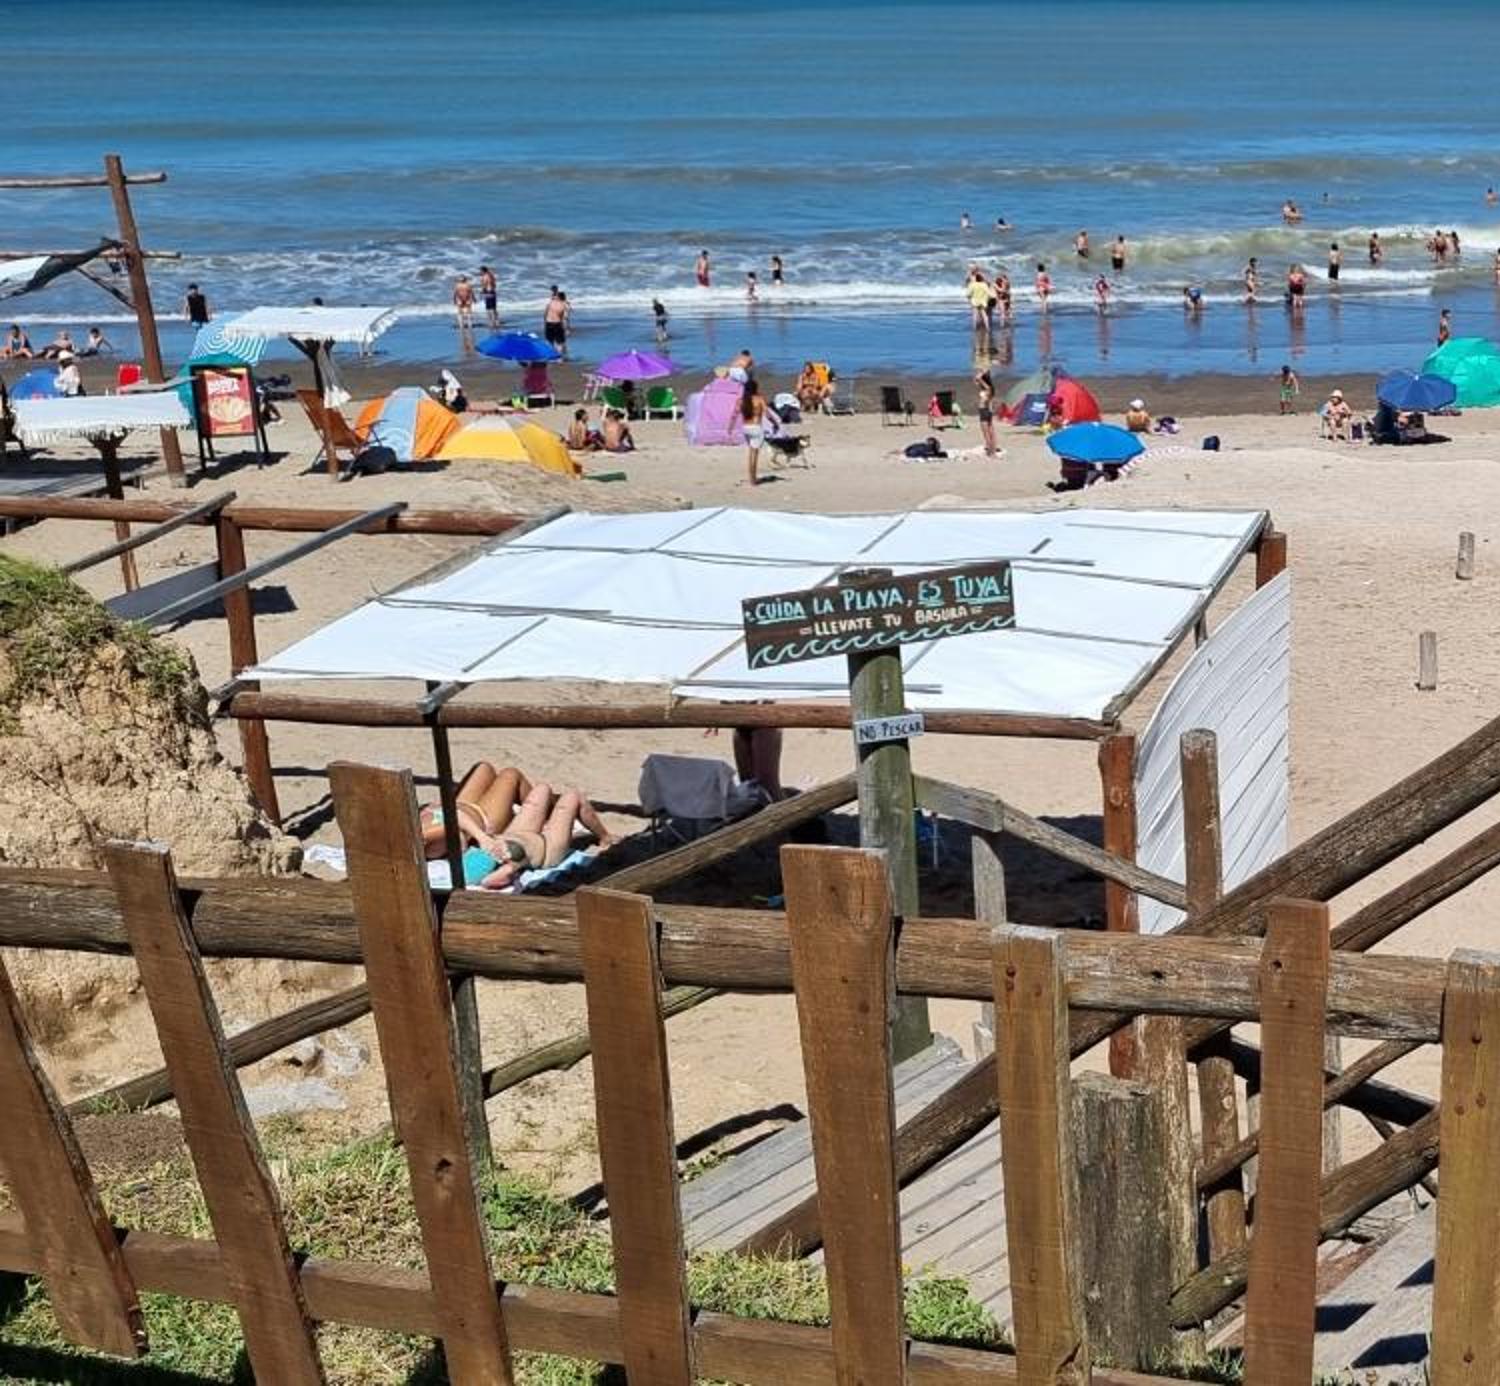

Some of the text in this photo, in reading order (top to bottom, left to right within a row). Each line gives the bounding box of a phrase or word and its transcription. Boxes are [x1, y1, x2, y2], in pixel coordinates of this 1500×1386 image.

[813, 597, 834, 614] LA
[841, 588, 912, 611] PLAYA,
[918, 580, 942, 601] ES
[950, 568, 1010, 597] TUYA!
[814, 605, 968, 636] LLEVATE TU BASURA
[859, 722, 922, 741] NO PESCAR
